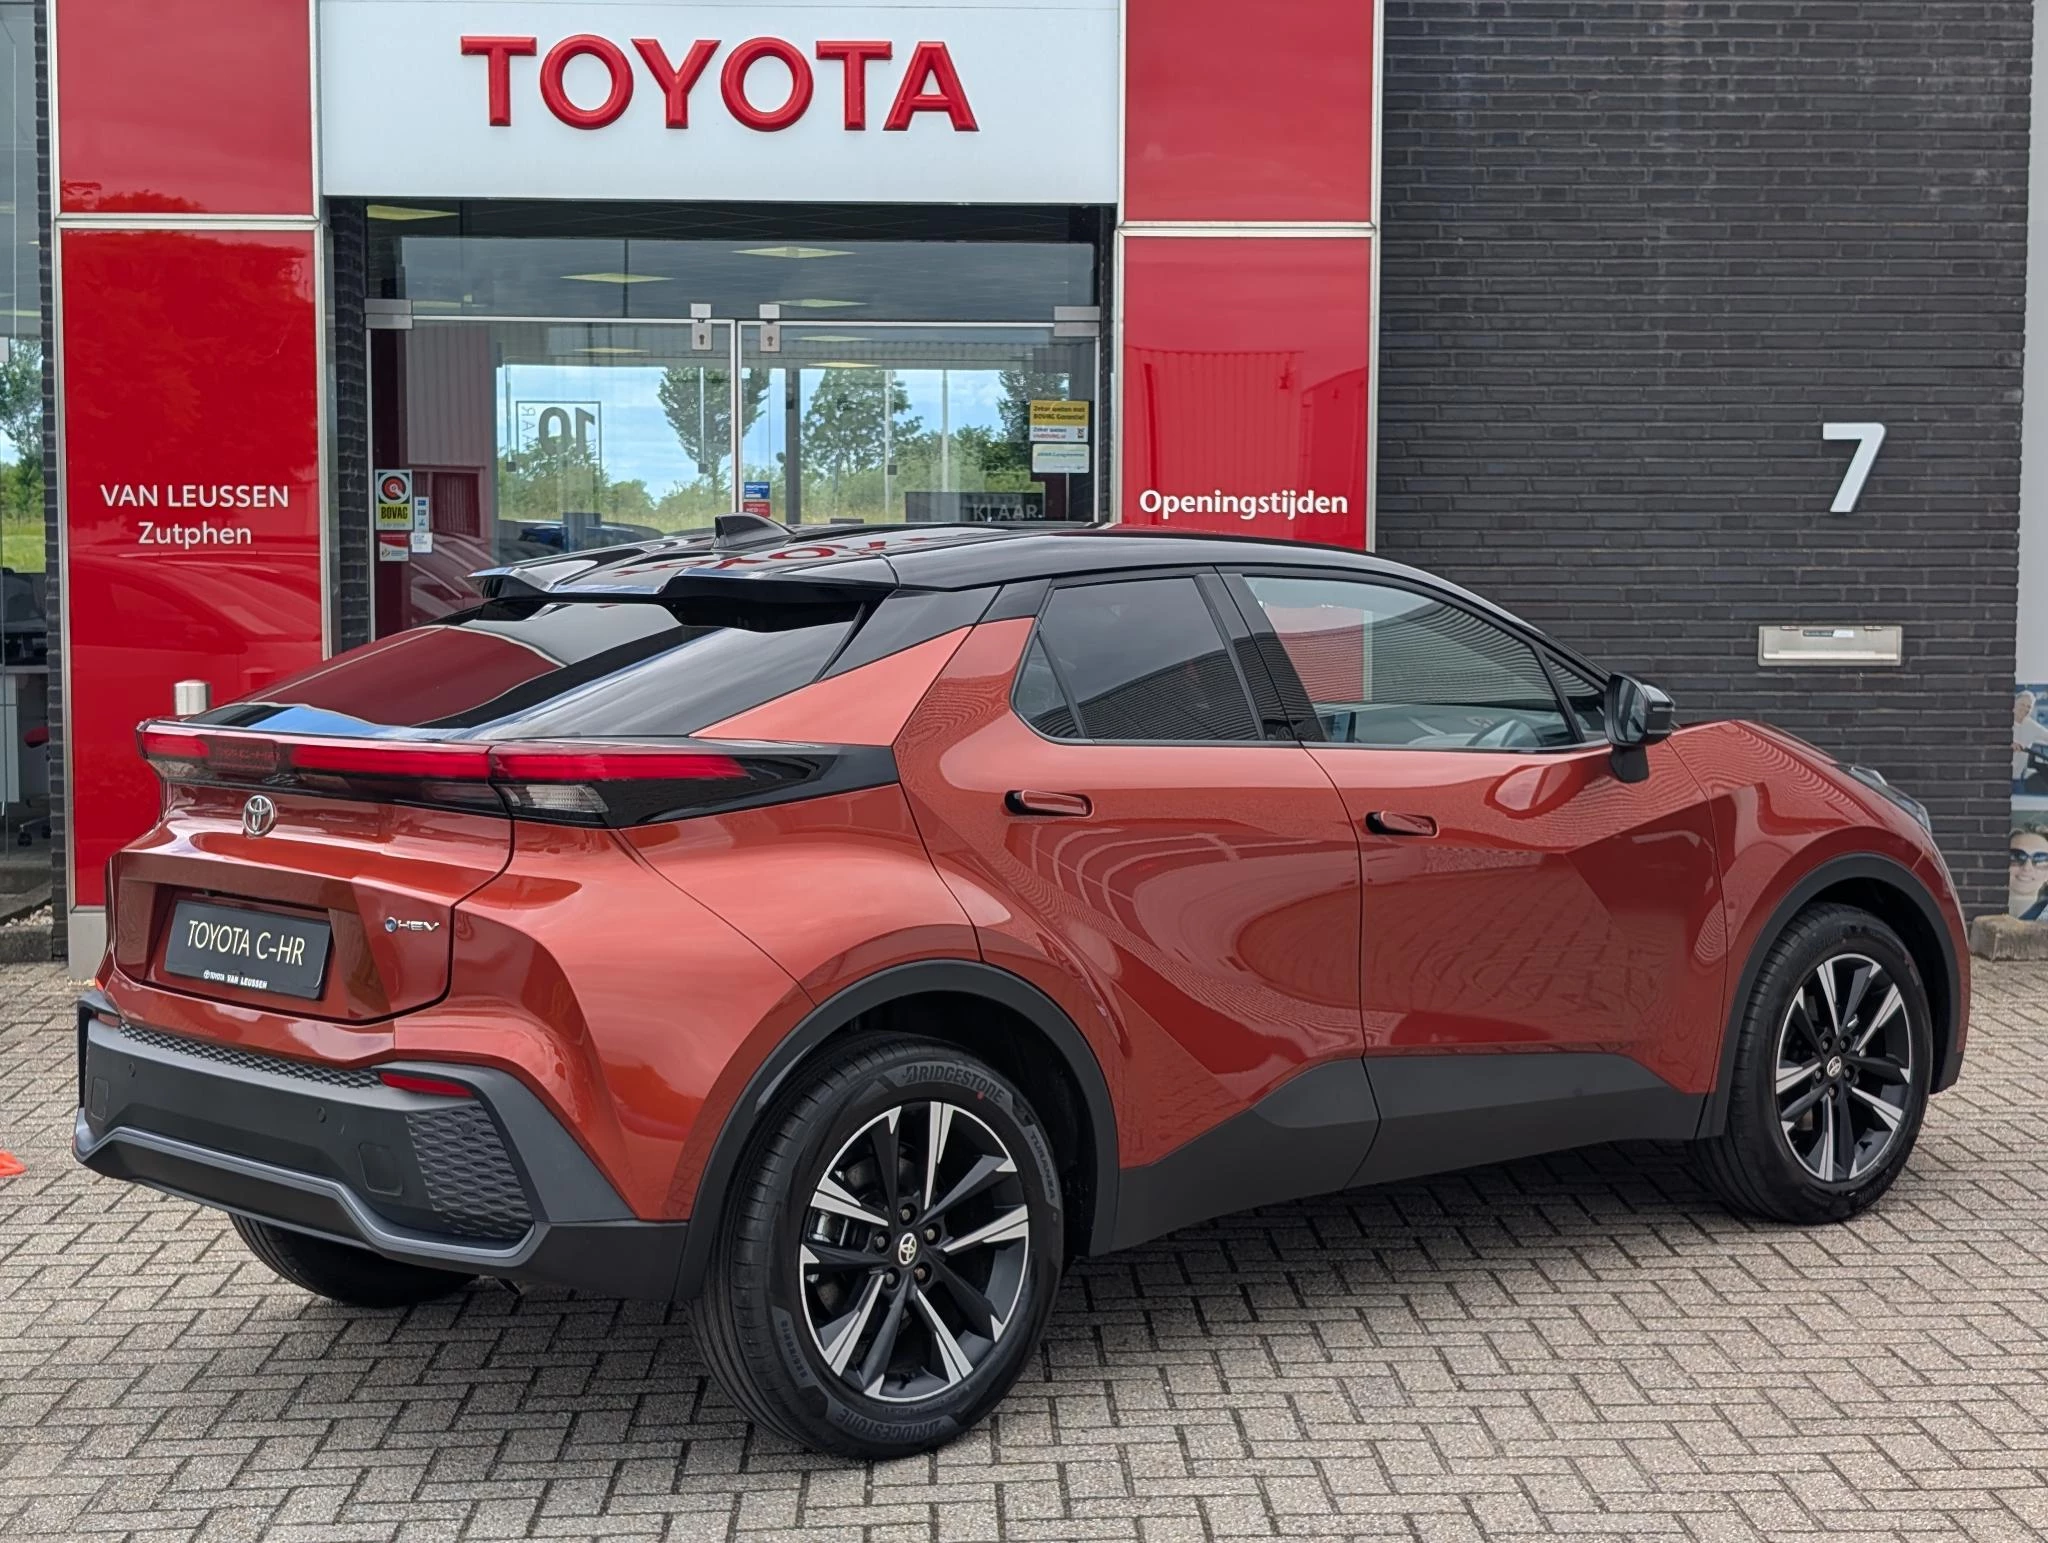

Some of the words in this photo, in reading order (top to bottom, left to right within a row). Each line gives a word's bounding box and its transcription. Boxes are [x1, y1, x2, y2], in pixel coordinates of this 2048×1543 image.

[460, 34, 980, 133] TOYOTA
[1823, 423, 1886, 512] 7
[100, 484, 158, 507] VAN
[167, 485, 289, 508] LEUSSEN
[1139, 489, 1349, 520] Openingstijden
[381, 506, 408, 520] BOVAG
[138, 521, 252, 550] Zutphen
[398, 920, 440, 931] HEV
[187, 920, 250, 957] TOYOTA
[256, 931, 306, 966] C-HR
[226, 974, 239, 983] VAN
[240, 976, 268, 989] LEUSSEN
[902, 1065, 1005, 1101] BRIDGESTONE
